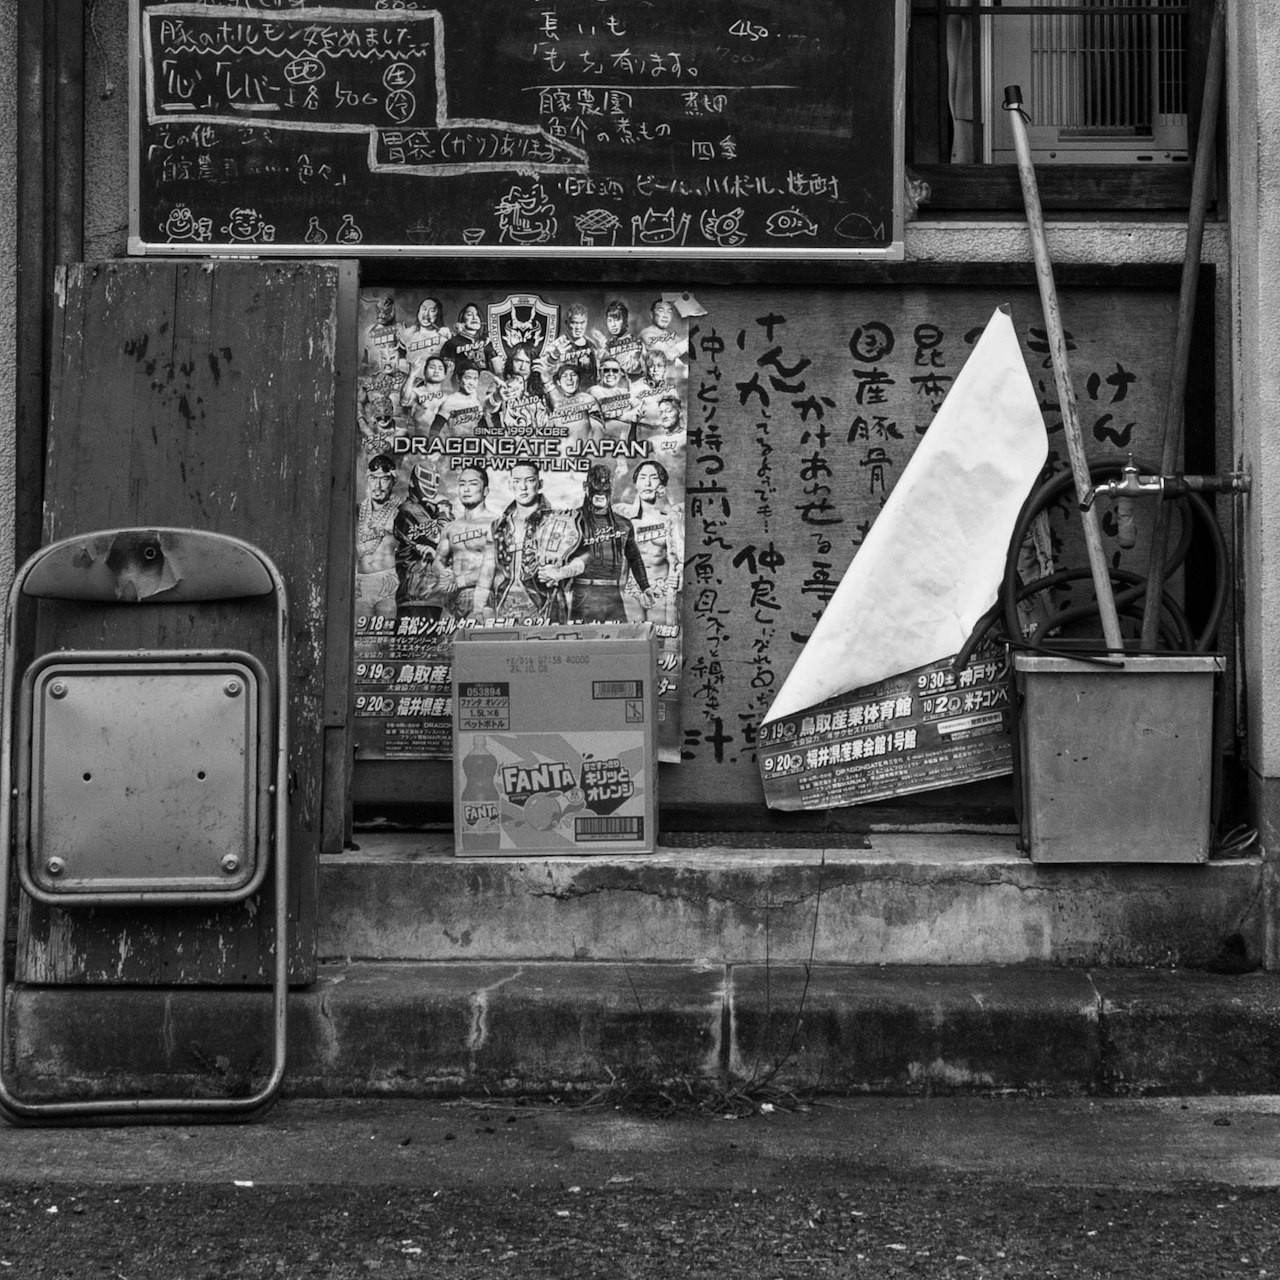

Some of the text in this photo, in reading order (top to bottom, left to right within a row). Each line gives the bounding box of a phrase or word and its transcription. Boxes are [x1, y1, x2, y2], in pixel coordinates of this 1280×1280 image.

[160, 19, 430, 48] 豚のホルモン始めました
[539, 12, 626, 41] 長いも
[474, 427, 568, 436] SINCE 1999 KOBE
[393, 437, 647, 458] DRAGONGATE JAPAN
[918, 671, 945, 689] 9/30
[466, 687, 502, 697] 053894
[461, 697, 508, 707] ファンタ オレンジ
[923, 696, 949, 714] 10/2
[464, 720, 505, 729] ペットボトル
[799, 696, 913, 738] 鳥取産業体育館
[764, 754, 791, 772] 9/20
[806, 729, 918, 770] 福井県産業会館1号館
[503, 763, 576, 794] FANTA
[584, 767, 631, 786] キリッと
[586, 782, 635, 801] オレンジ
[464, 805, 500, 821] FANTA
